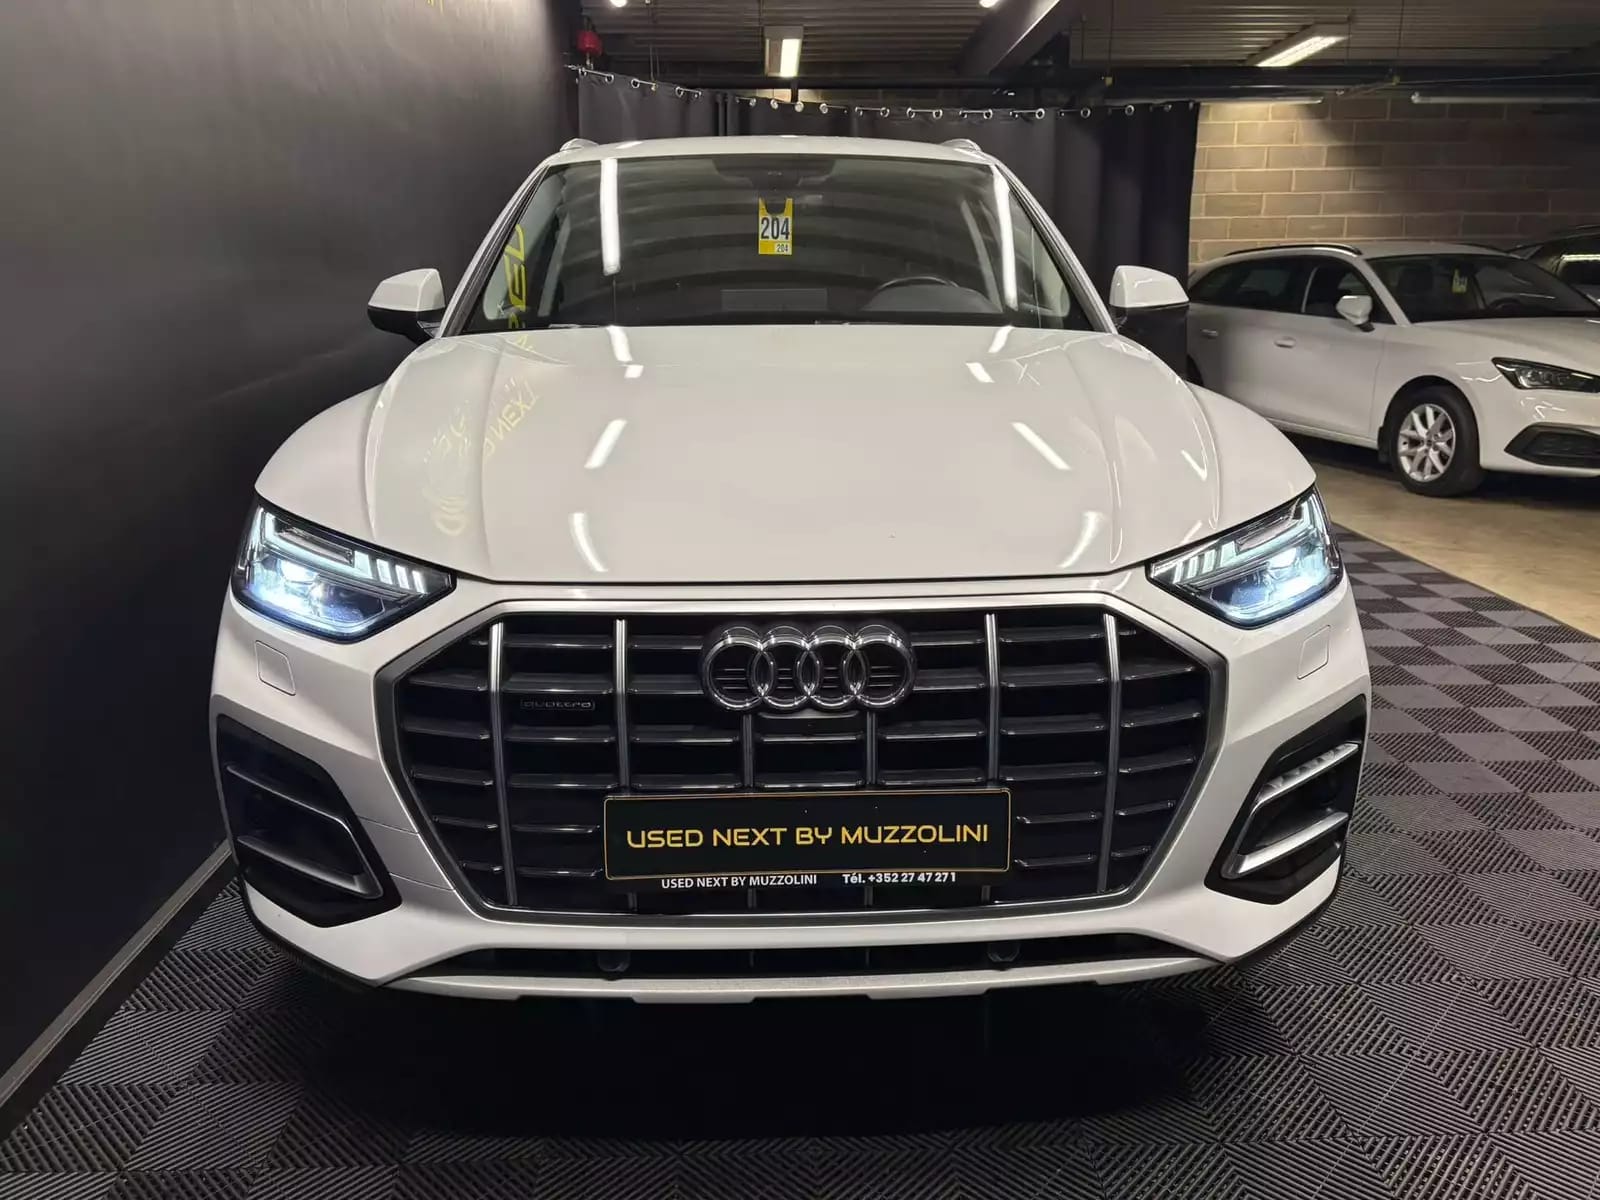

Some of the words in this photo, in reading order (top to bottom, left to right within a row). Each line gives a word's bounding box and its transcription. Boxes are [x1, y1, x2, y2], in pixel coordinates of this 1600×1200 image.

[760, 217, 790, 240] 204
[776, 243, 789, 253] 204
[626, 829, 703, 848] USED
[713, 827, 787, 846] NEXT
[795, 826, 833, 845] BY
[842, 824, 988, 844] MUZZOLINI
[661, 878, 694, 889] USED
[696, 876, 728, 888] NEXT
[731, 876, 746, 887] BY
[749, 874, 817, 887] MUZZOLINI
[842, 872, 866, 884] Tél.
[868, 872, 898, 883] +352
[900, 872, 915, 882] 27
[917, 872, 933, 882] 47
